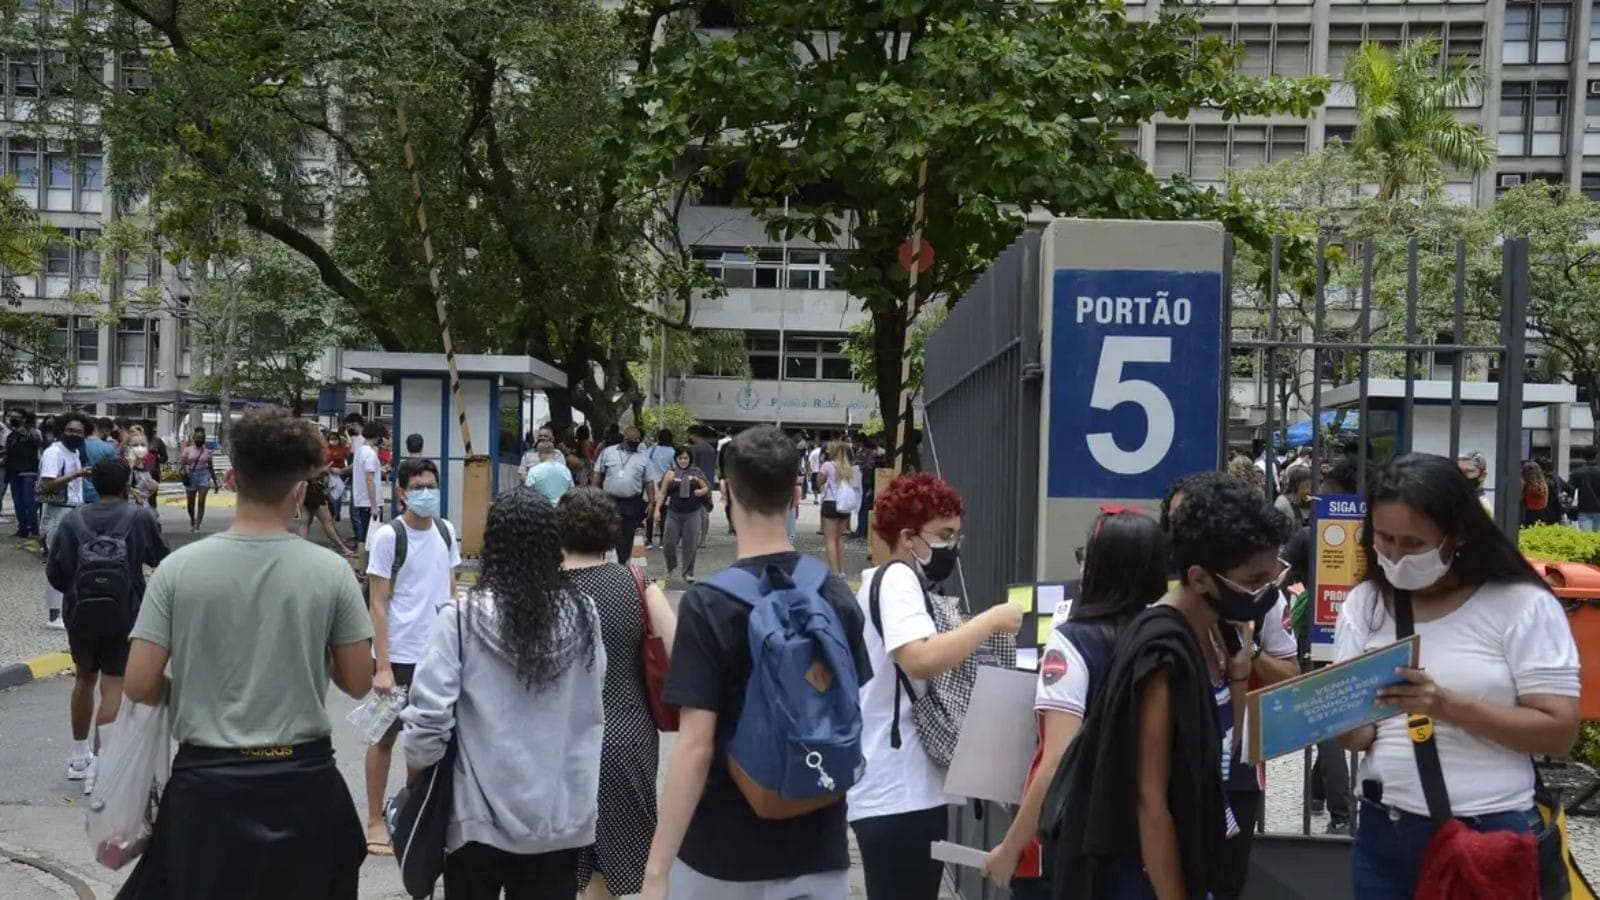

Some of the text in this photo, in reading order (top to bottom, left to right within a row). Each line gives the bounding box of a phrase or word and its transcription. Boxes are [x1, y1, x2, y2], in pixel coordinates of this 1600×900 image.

[1076, 290, 1192, 326] PORTÃO
[1086, 335, 1175, 475] 5
[1328, 501, 1356, 513] SIGA
